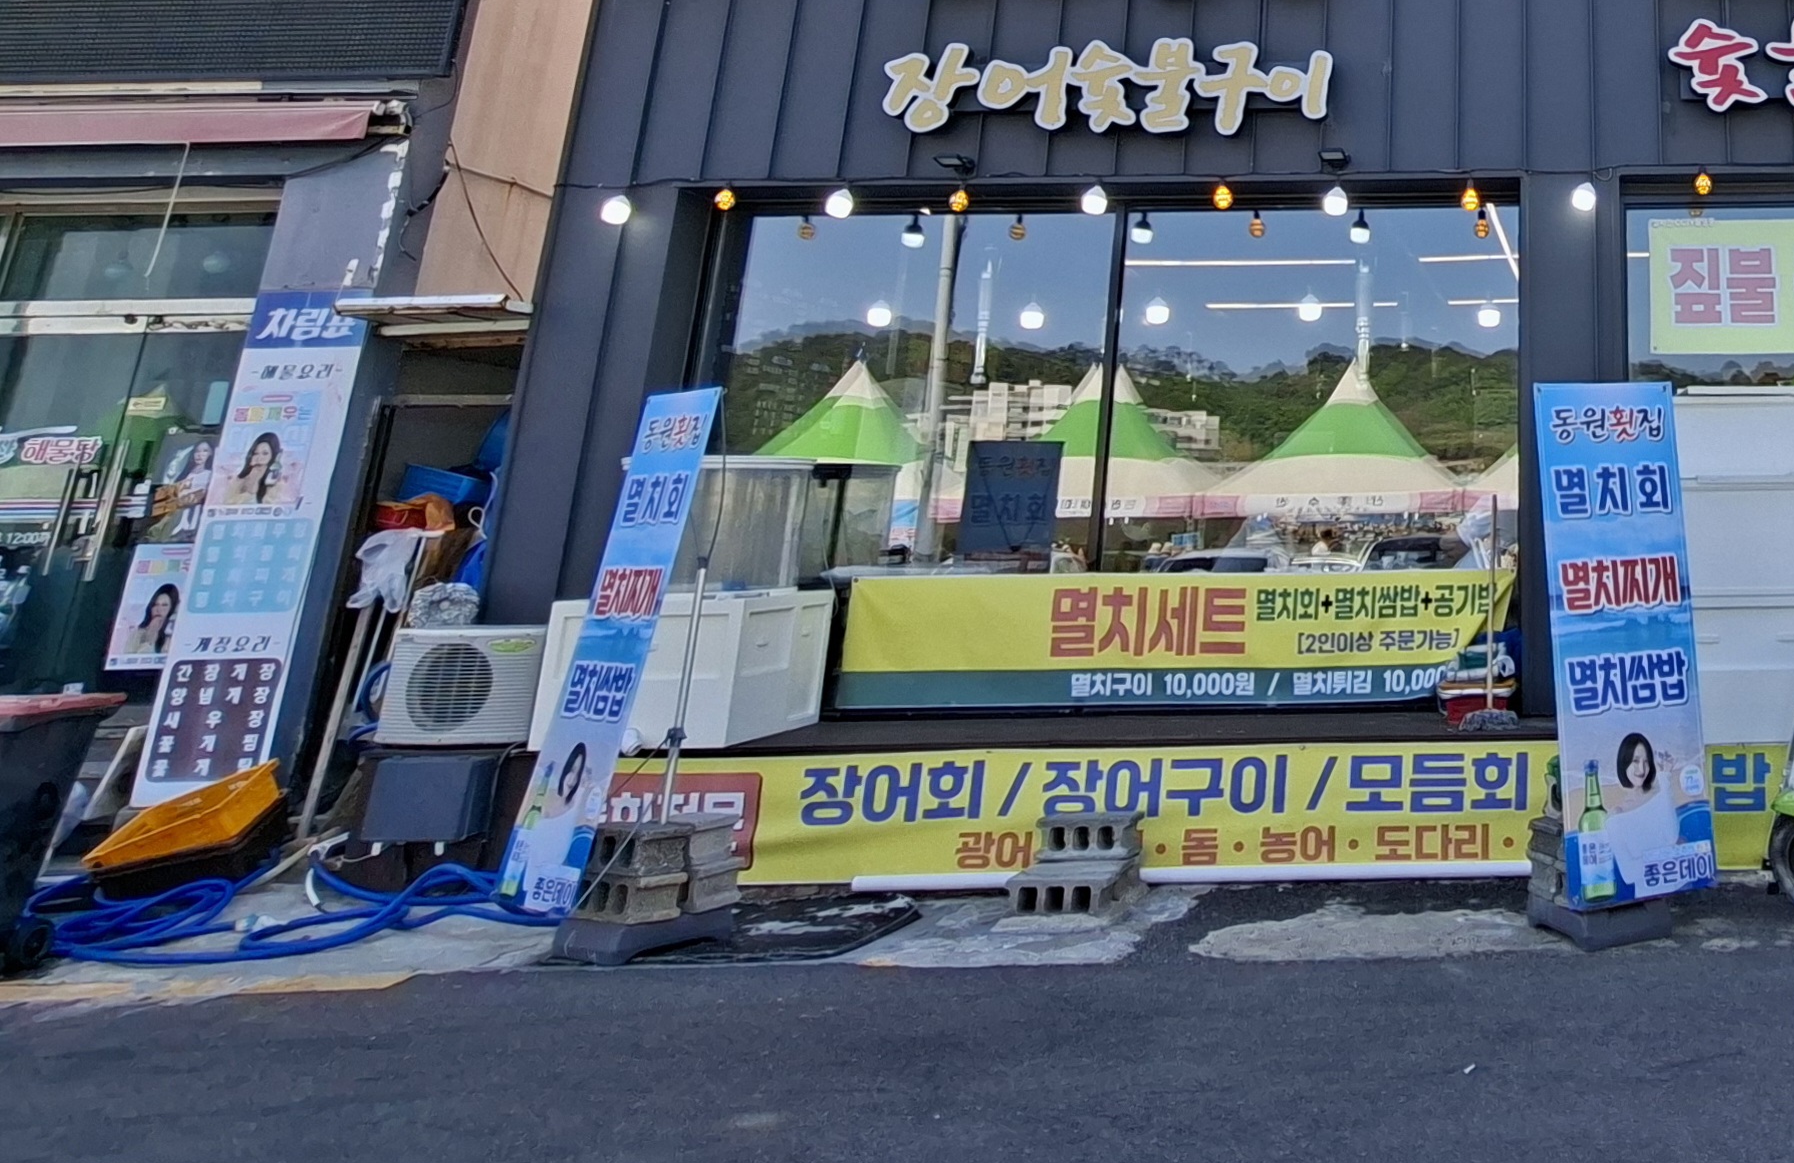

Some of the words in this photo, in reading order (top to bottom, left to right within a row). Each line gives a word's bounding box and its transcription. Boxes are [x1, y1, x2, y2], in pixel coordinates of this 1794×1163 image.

[1668, 246, 1777, 325] 짚불
[255, 307, 358, 340] 차림표
[1549, 405, 1665, 443] 동원횟집
[621, 472, 692, 527] 멸치회
[1552, 463, 1673, 518] 멸치회
[592, 565, 666, 623] 멸치찌개
[1560, 553, 1681, 616] 멸치찌개
[1048, 585, 1248, 659] 멸치세트
[561, 660, 636, 723] 멸치쌈밥
[1070, 672, 1153, 699] 멸치구이
[1163, 671, 1256, 700] 10,000원
[1292, 668, 1373, 697] 멸치튀김
[1566, 648, 1689, 717] 멸치쌈밥
[799, 758, 986, 828] 장어회
[1040, 753, 1288, 820] 장어구이
[1345, 750, 1529, 816] 모듬회
[954, 830, 1034, 871] 광어
[1180, 826, 1220, 866] 돔
[1258, 824, 1337, 864] 농어
[1374, 822, 1491, 862] 도다리
[1643, 854, 1714, 888] 좋은데이
